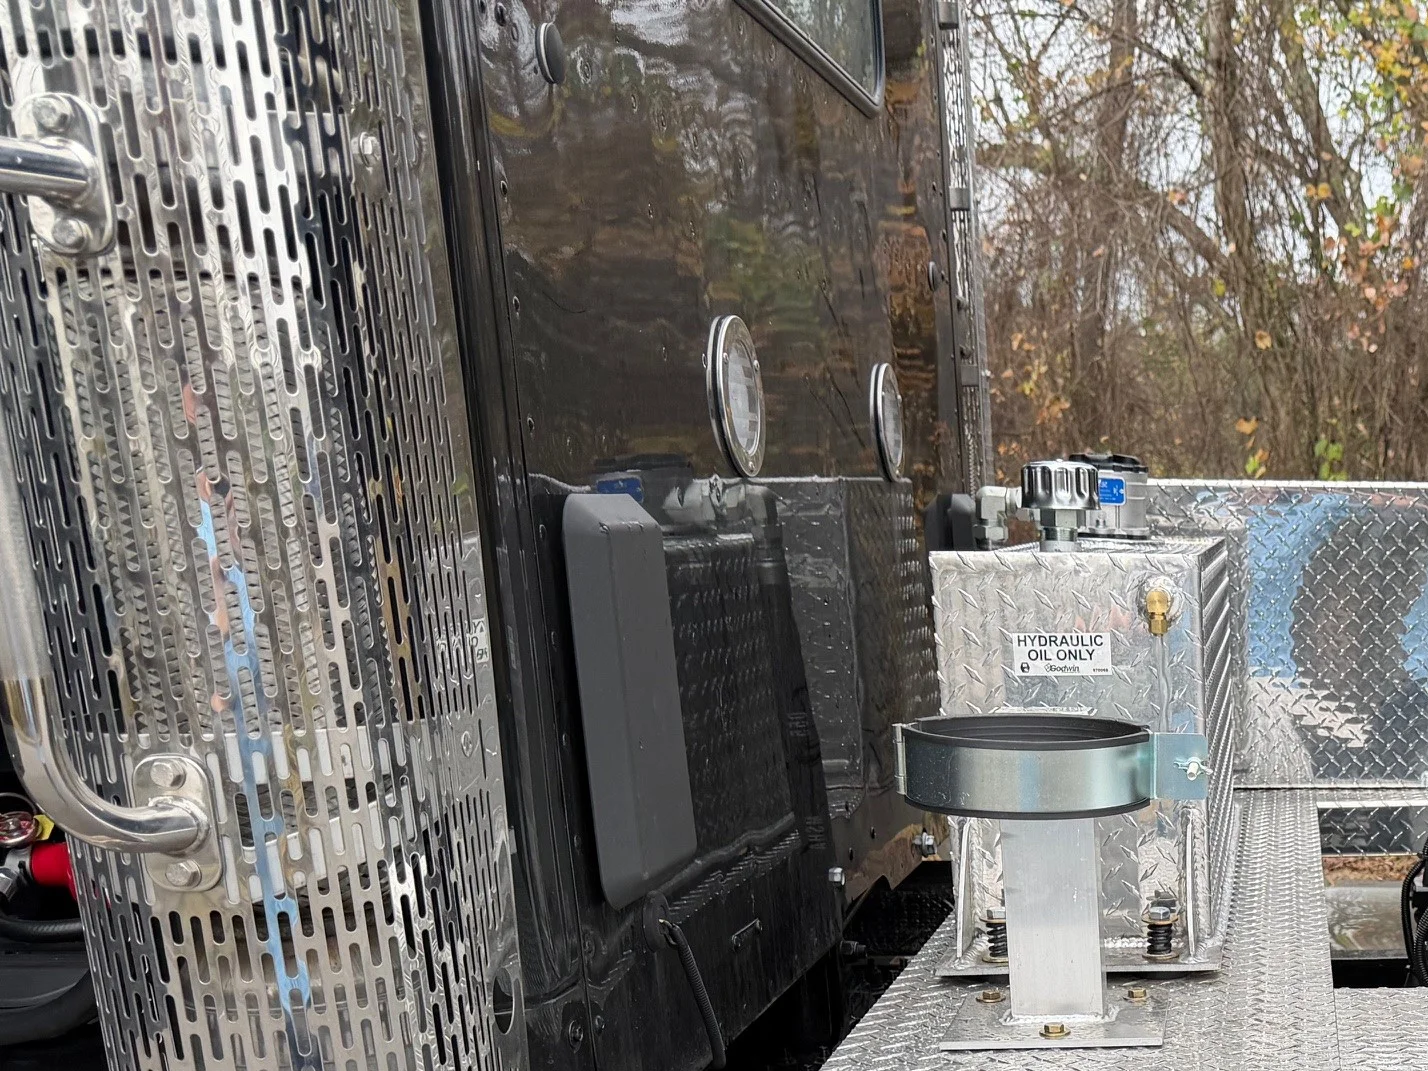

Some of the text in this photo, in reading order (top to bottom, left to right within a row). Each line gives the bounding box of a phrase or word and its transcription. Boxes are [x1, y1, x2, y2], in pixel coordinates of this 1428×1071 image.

[1017, 634, 1104, 647] HYDRAULIC
[1027, 649, 1095, 661] OIL ONLY
